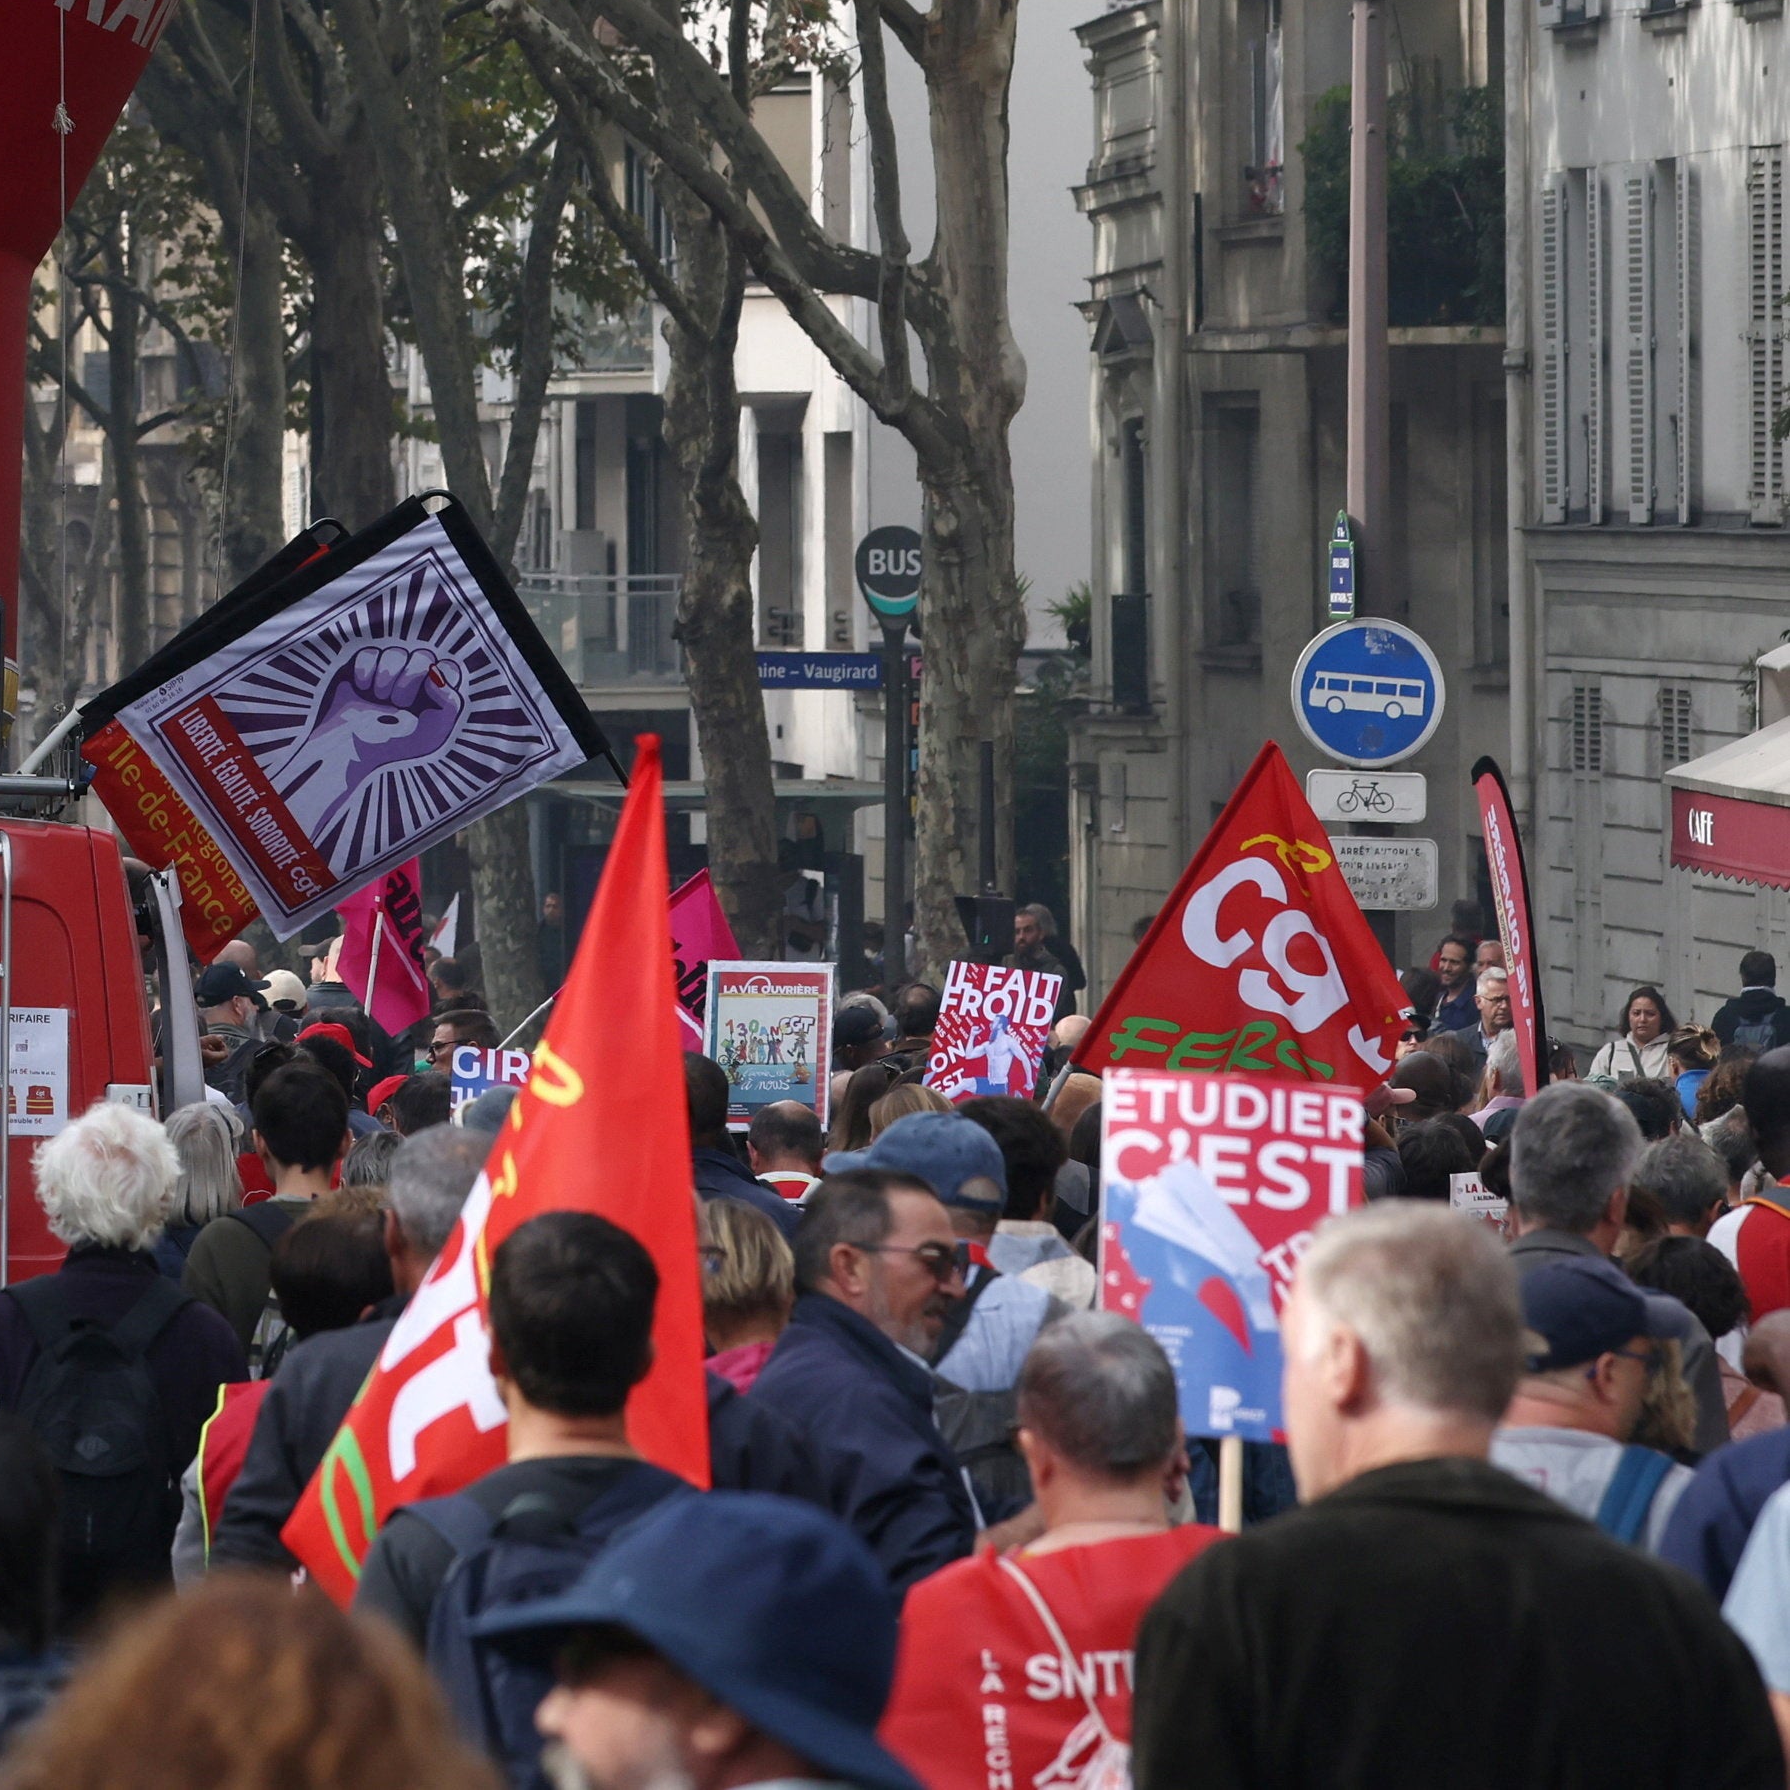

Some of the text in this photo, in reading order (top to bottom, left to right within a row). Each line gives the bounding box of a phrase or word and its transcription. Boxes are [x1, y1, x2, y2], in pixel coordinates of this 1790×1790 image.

[868, 549, 922, 576] BUS
[758, 663, 877, 683] ine Vaugirard
[178, 708, 307, 869] LIBERTÉ, ÉGALITÉ, SORORITÉ
[107, 735, 233, 935] Île-de-France
[290, 866, 322, 898] cgt
[723, 983, 820, 994] LA VIE OUVRIÈRE
[947, 960, 1063, 1001] IL FAIT
[938, 982, 1055, 1027] FROID
[725, 1018, 760, 1037] 130
[779, 1015, 816, 1036] CGT
[452, 1045, 530, 1083] GIR
[930, 1039, 966, 1073] ON
[1103, 1069, 1366, 1145] ÉTUDIER
[1103, 1127, 1365, 1216] C'EST
[1465, 1183, 1478, 1194] LA
